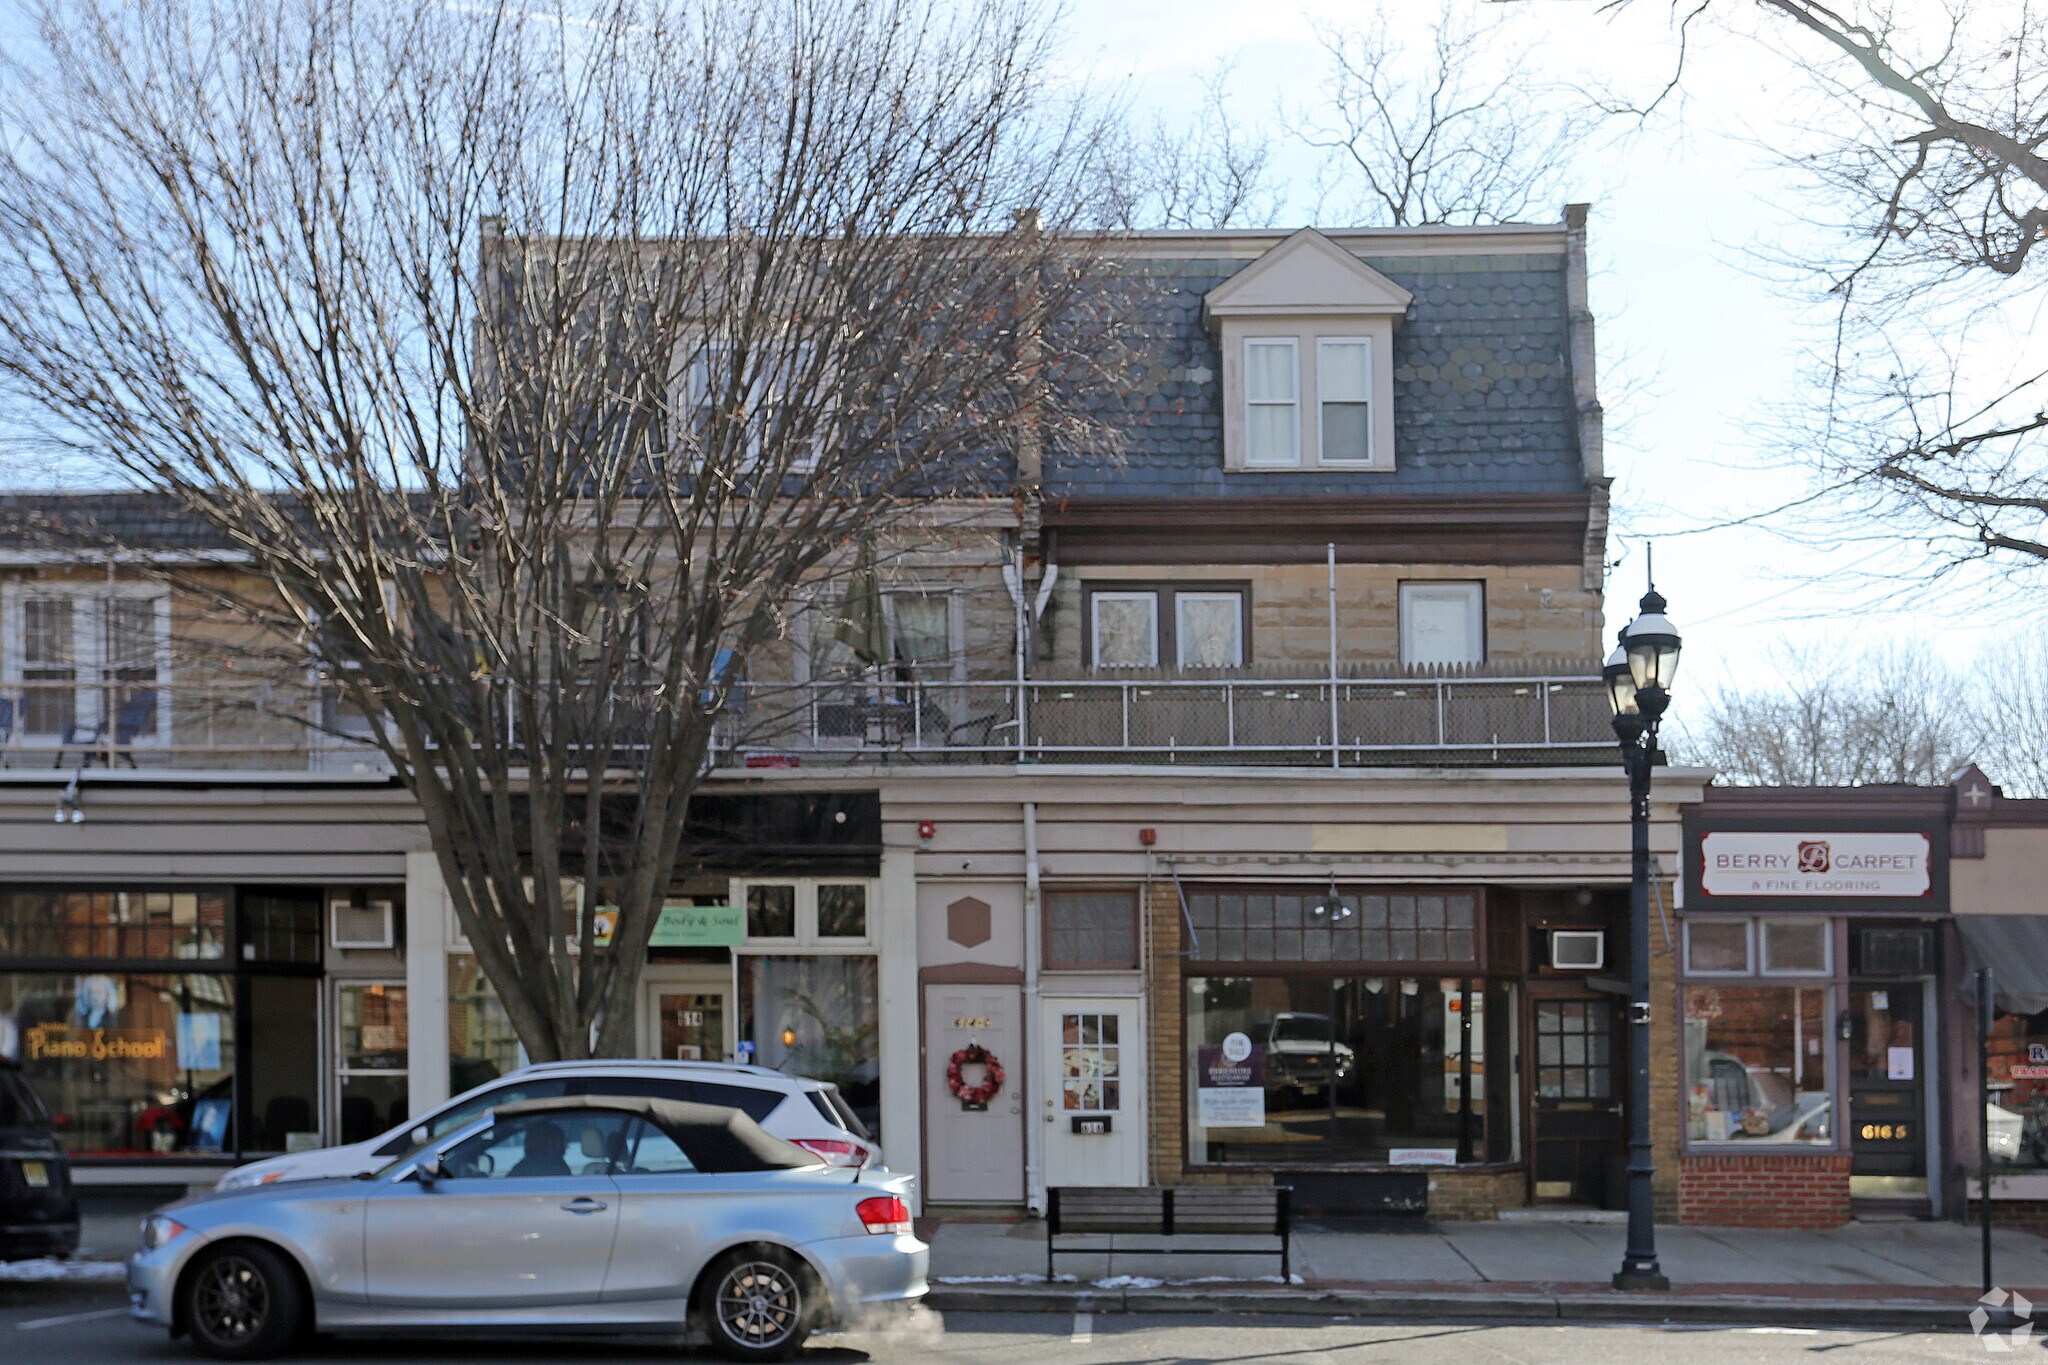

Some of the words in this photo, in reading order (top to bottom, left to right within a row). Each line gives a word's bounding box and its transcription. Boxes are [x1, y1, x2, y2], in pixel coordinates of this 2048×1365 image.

[1716, 854, 1792, 869] BERRY
[1835, 854, 1918, 869] CARPET
[1751, 880, 1761, 891] &
[1766, 880, 1800, 891] FINE
[1805, 880, 1881, 891] FLOORING
[27, 1026, 87, 1061] Piano
[91, 1027, 166, 1061] School
